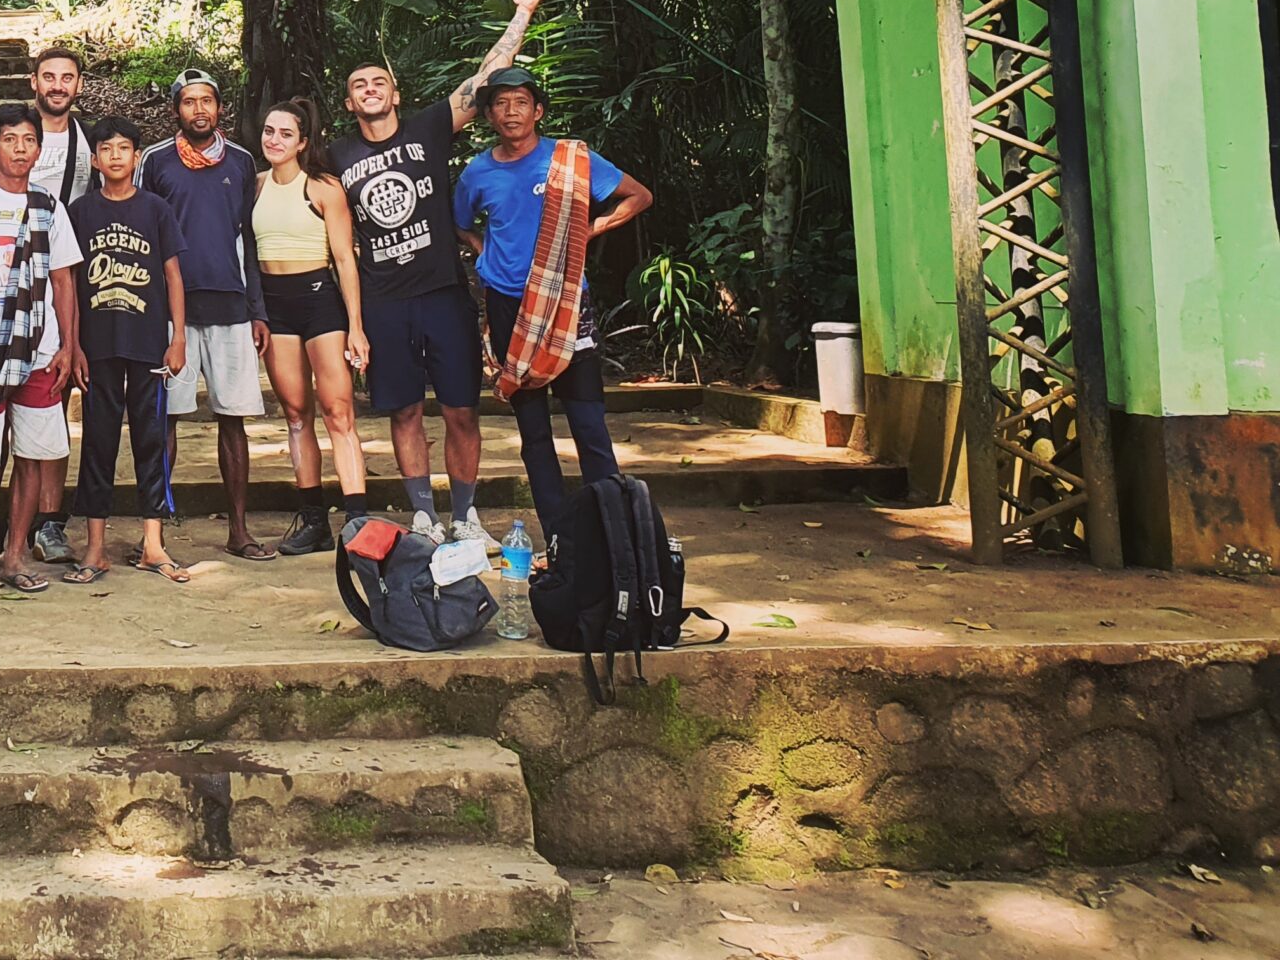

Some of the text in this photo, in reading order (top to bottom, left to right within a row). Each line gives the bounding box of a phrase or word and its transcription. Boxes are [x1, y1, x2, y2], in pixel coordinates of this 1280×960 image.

[341, 143, 425, 193] PROPERTY OF
[416, 175, 434, 198] 83
[354, 204, 367, 222] 19
[111, 223, 128, 232] The
[370, 219, 430, 250] EAST SIDE
[89, 233, 151, 255] LEGEND
[389, 242, 413, 256] CREW
[88, 252, 151, 287] Djogja
